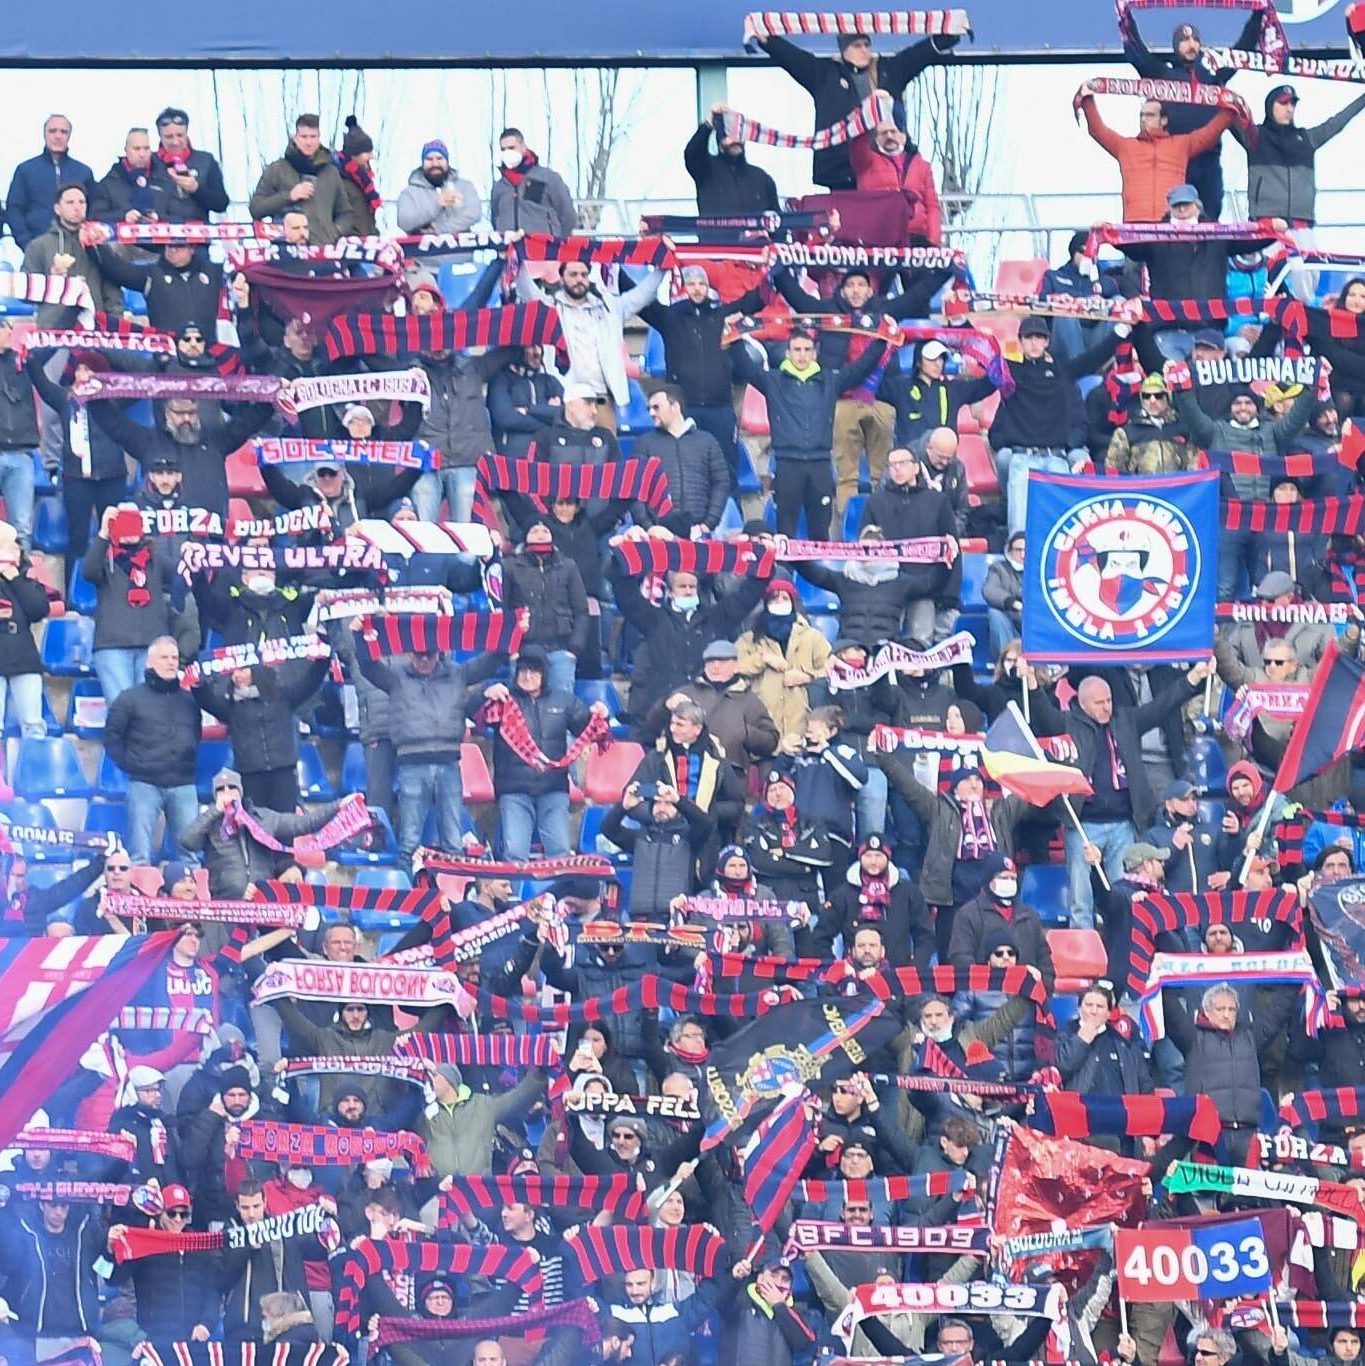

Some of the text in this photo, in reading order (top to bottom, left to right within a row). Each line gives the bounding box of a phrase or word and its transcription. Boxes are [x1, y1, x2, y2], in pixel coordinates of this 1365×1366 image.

[1107, 80, 1196, 104] BOLOGNA
[777, 246, 955, 269] BOLOGNA FC 1909
[1196, 359, 1295, 385] BOLOGNA
[141, 508, 223, 535] FORZA
[1053, 502, 1128, 552] CURVA
[1233, 605, 1328, 625] BOLOGNA
[1260, 1134, 1347, 1164] FORZA
[1123, 1238, 1269, 1286] 40033
[871, 1284, 1038, 1309] 40033
